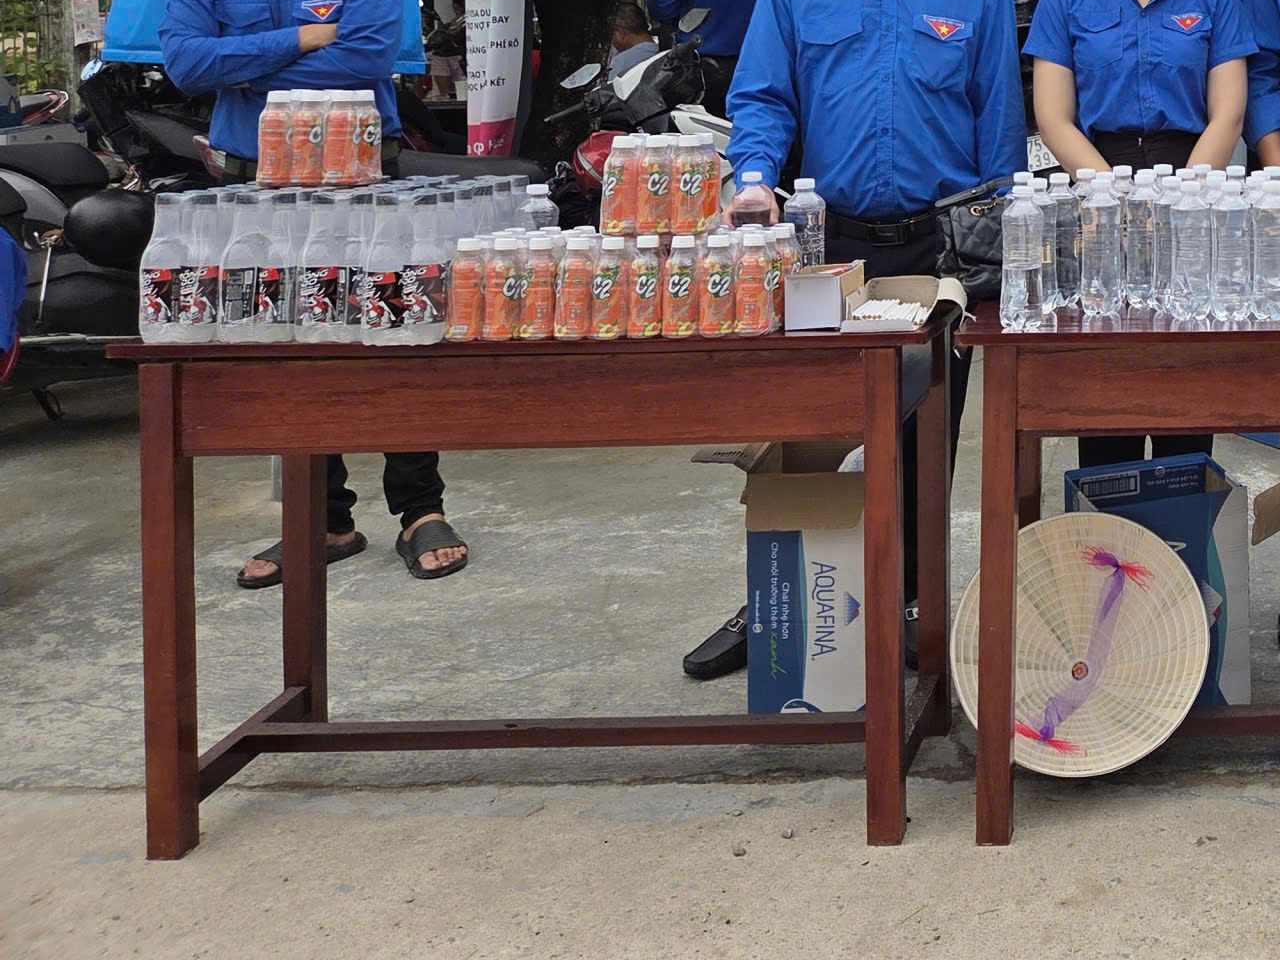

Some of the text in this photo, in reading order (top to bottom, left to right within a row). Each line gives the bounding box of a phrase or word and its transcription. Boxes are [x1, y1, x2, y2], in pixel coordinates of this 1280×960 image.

[492, 16, 510, 24] BAY
[490, 76, 506, 86] KẾT
[648, 173, 670, 196] C2
[680, 172, 702, 195] C2
[636, 274, 658, 298] C2
[668, 274, 692, 298] C2
[707, 274, 732, 298] C2
[768, 542, 787, 680] Cho môi trường thêm xanh
[780, 582, 790, 640] Chai nhẹ hơn
[812, 561, 837, 658] AQUAFINA
